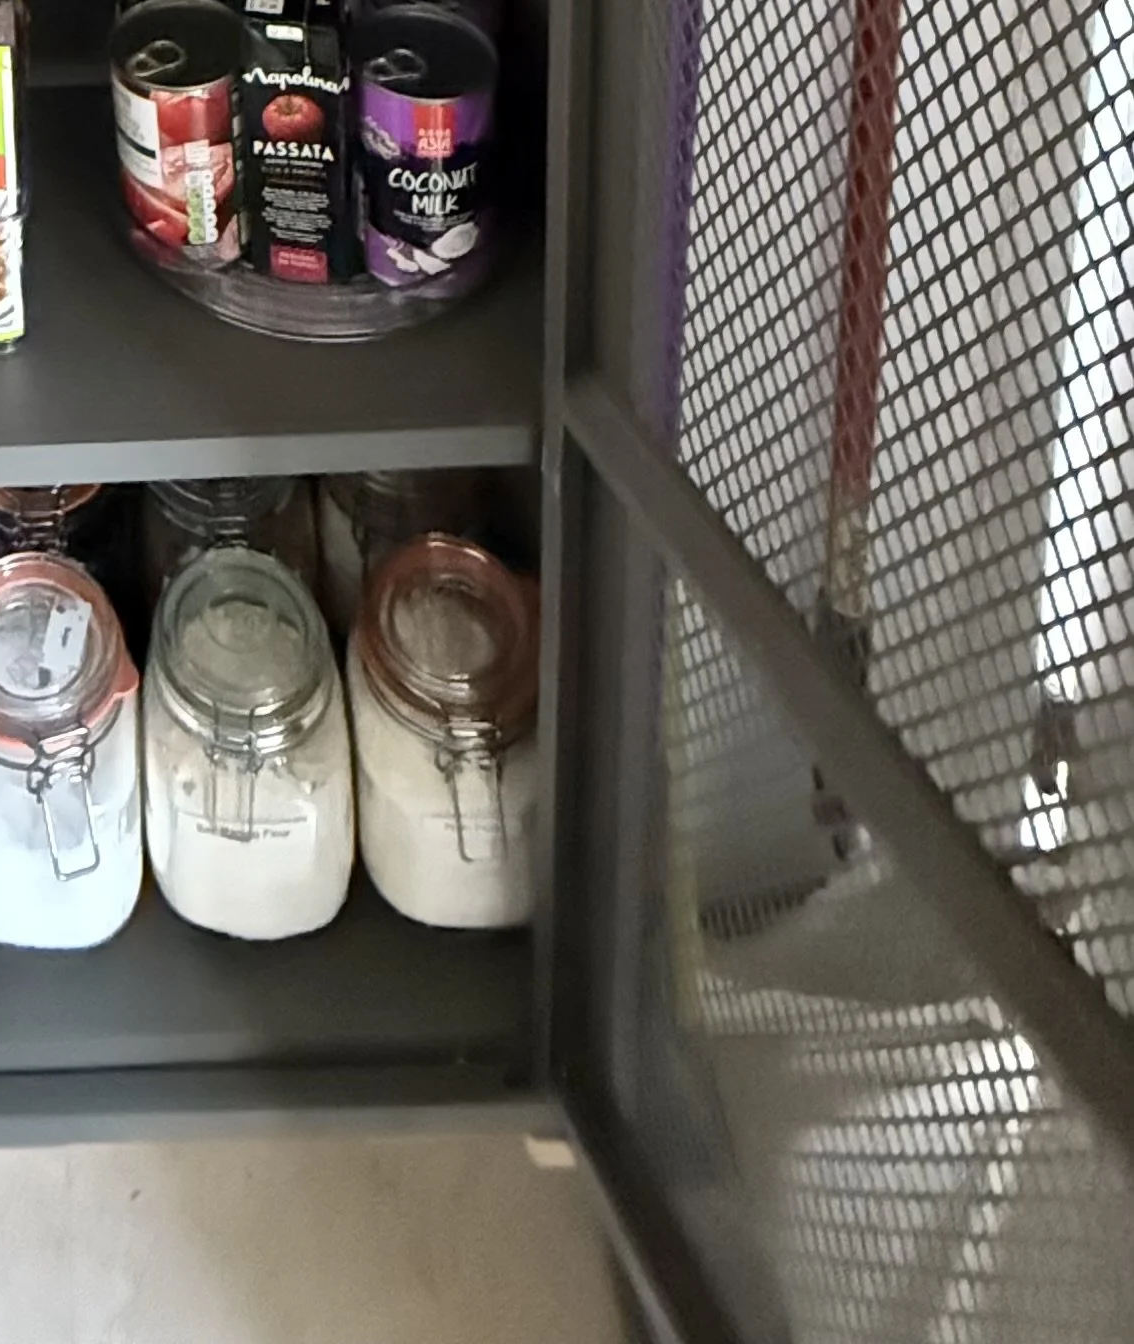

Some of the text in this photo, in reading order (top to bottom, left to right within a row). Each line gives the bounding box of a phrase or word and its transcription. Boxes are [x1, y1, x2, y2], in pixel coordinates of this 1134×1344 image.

[242, 65, 350, 95] Napolina
[252, 140, 335, 162] PASSATA
[388, 161, 479, 193] COCONUT
[411, 194, 460, 216] MILK
